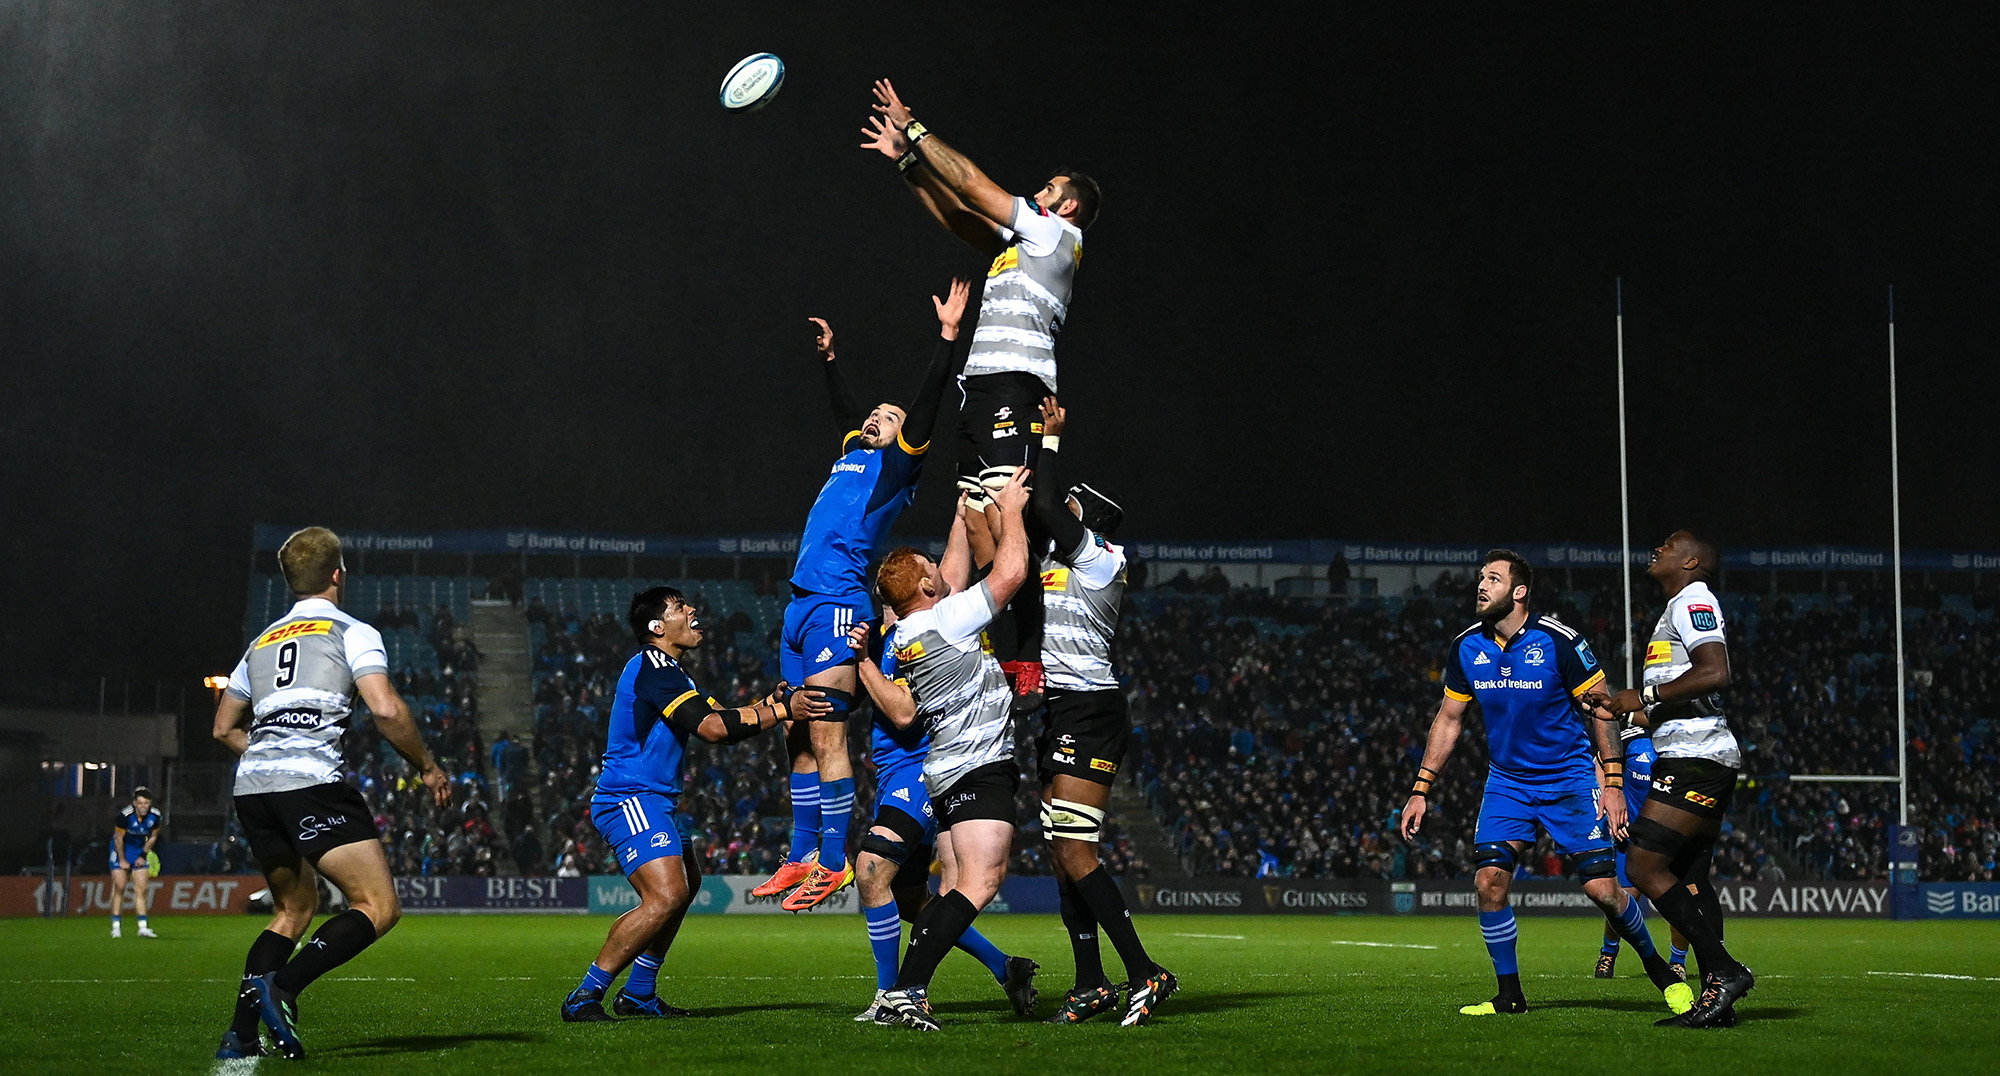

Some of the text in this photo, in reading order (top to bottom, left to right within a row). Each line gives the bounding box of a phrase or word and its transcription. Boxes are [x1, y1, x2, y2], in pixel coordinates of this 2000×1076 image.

[993, 427, 1018, 439] BLK
[377, 535, 433, 550] Ireland
[527, 533, 646, 552] Bank of Ireland
[741, 538, 798, 552] Bank of
[1158, 545, 1273, 560] Bank of Ireland
[1364, 546, 1478, 562] Bank of Ireland
[1568, 547, 1606, 562] Bank
[1771, 550, 1884, 566] Bank of Ireland
[1973, 554, 2000, 568] Ban
[267, 622, 317, 643] DHL
[274, 638, 300, 690] 9
[1473, 678, 1543, 690] Bank of Ireland
[1053, 751, 1076, 765] BLK
[1632, 771, 1651, 782] Bank
[1652, 781, 1673, 795] BLK
[393, 876, 448, 899] EST
[486, 877, 564, 900] BEST
[76, 880, 239, 915] JUST EAT
[1156, 888, 1242, 907] GUINNESS
[1282, 888, 1369, 908] GUINNESS
[1445, 891, 1478, 907] UNITE
[1768, 885, 1888, 914] AIRWAY
